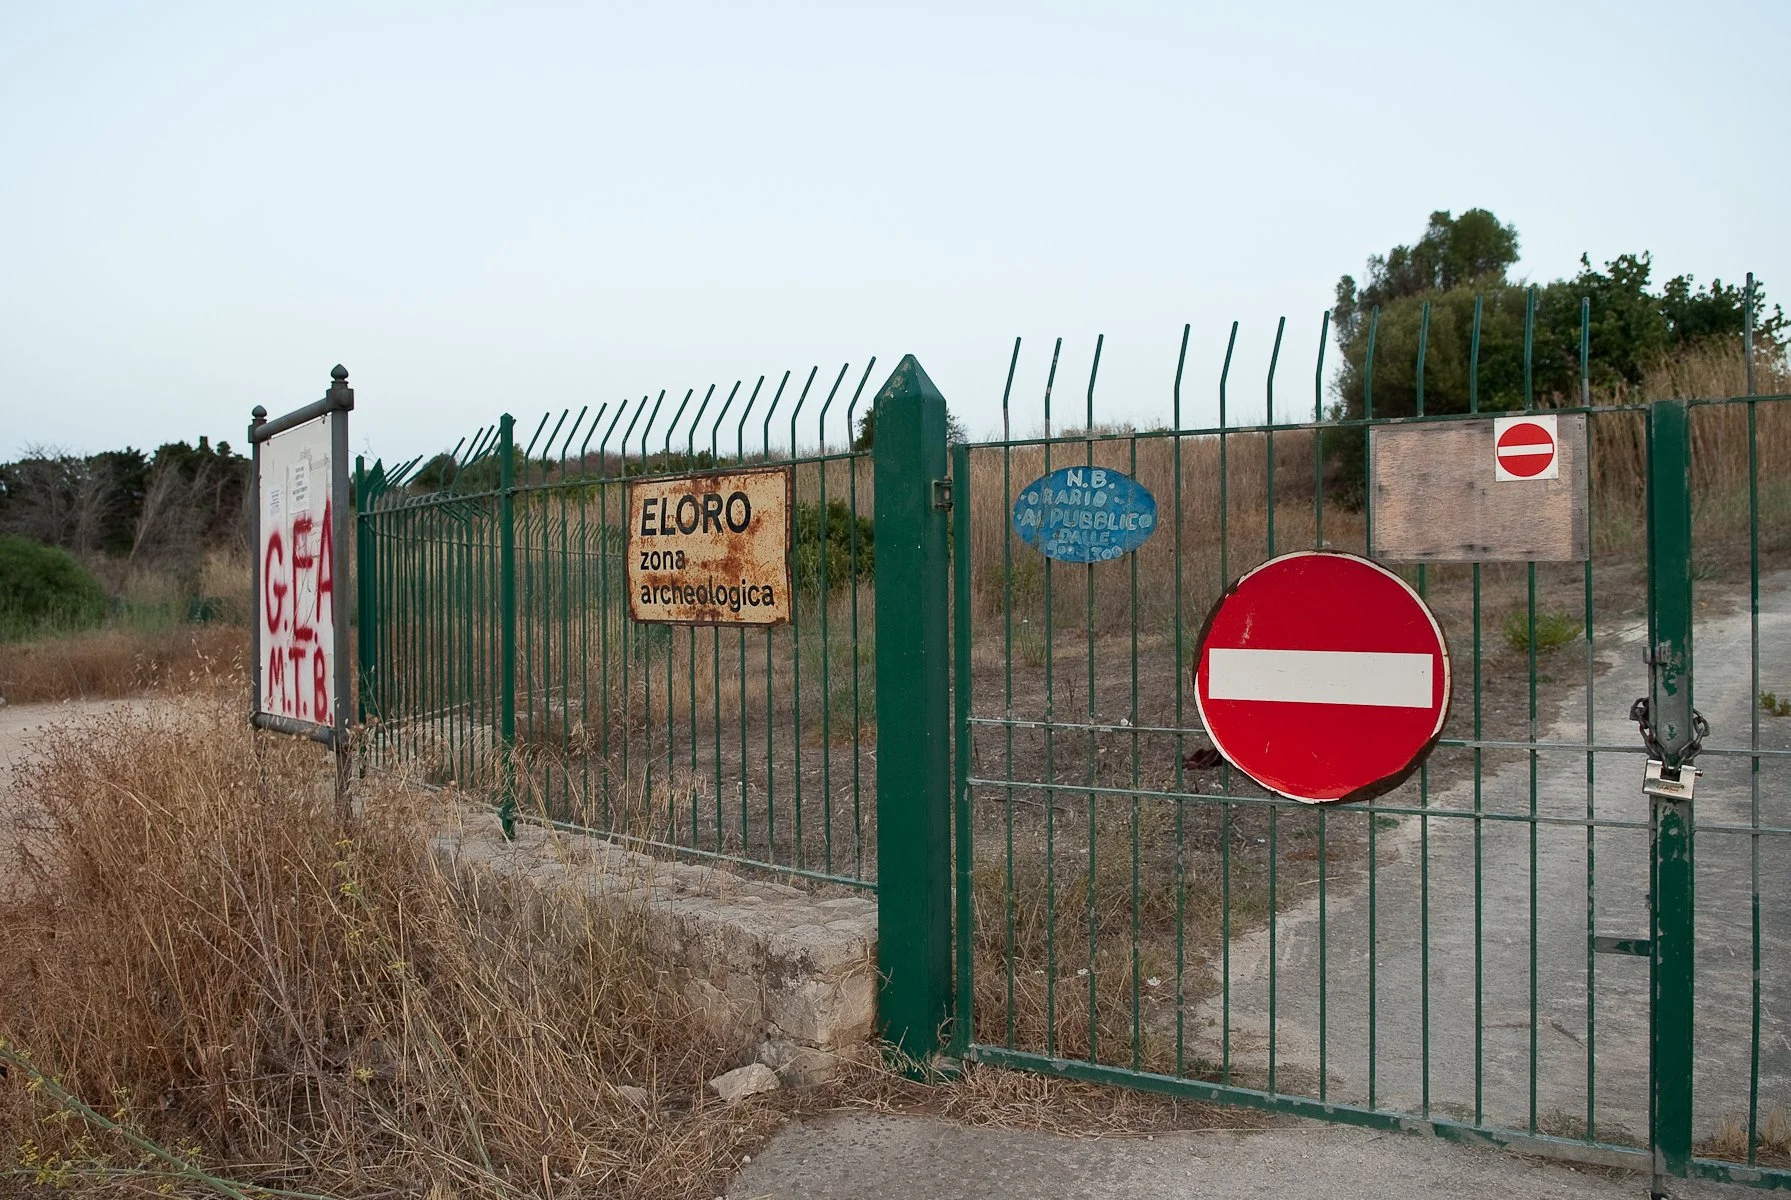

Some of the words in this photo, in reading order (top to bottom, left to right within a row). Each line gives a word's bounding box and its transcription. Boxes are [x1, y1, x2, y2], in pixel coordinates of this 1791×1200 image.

[1067, 469, 1115, 489] N.B.
[1027, 488, 1108, 507] ORARIO
[640, 491, 752, 537] ELORO
[1050, 508, 1153, 531] PUBBLICO
[640, 549, 686, 571] zona
[640, 575, 775, 613] archeologica
